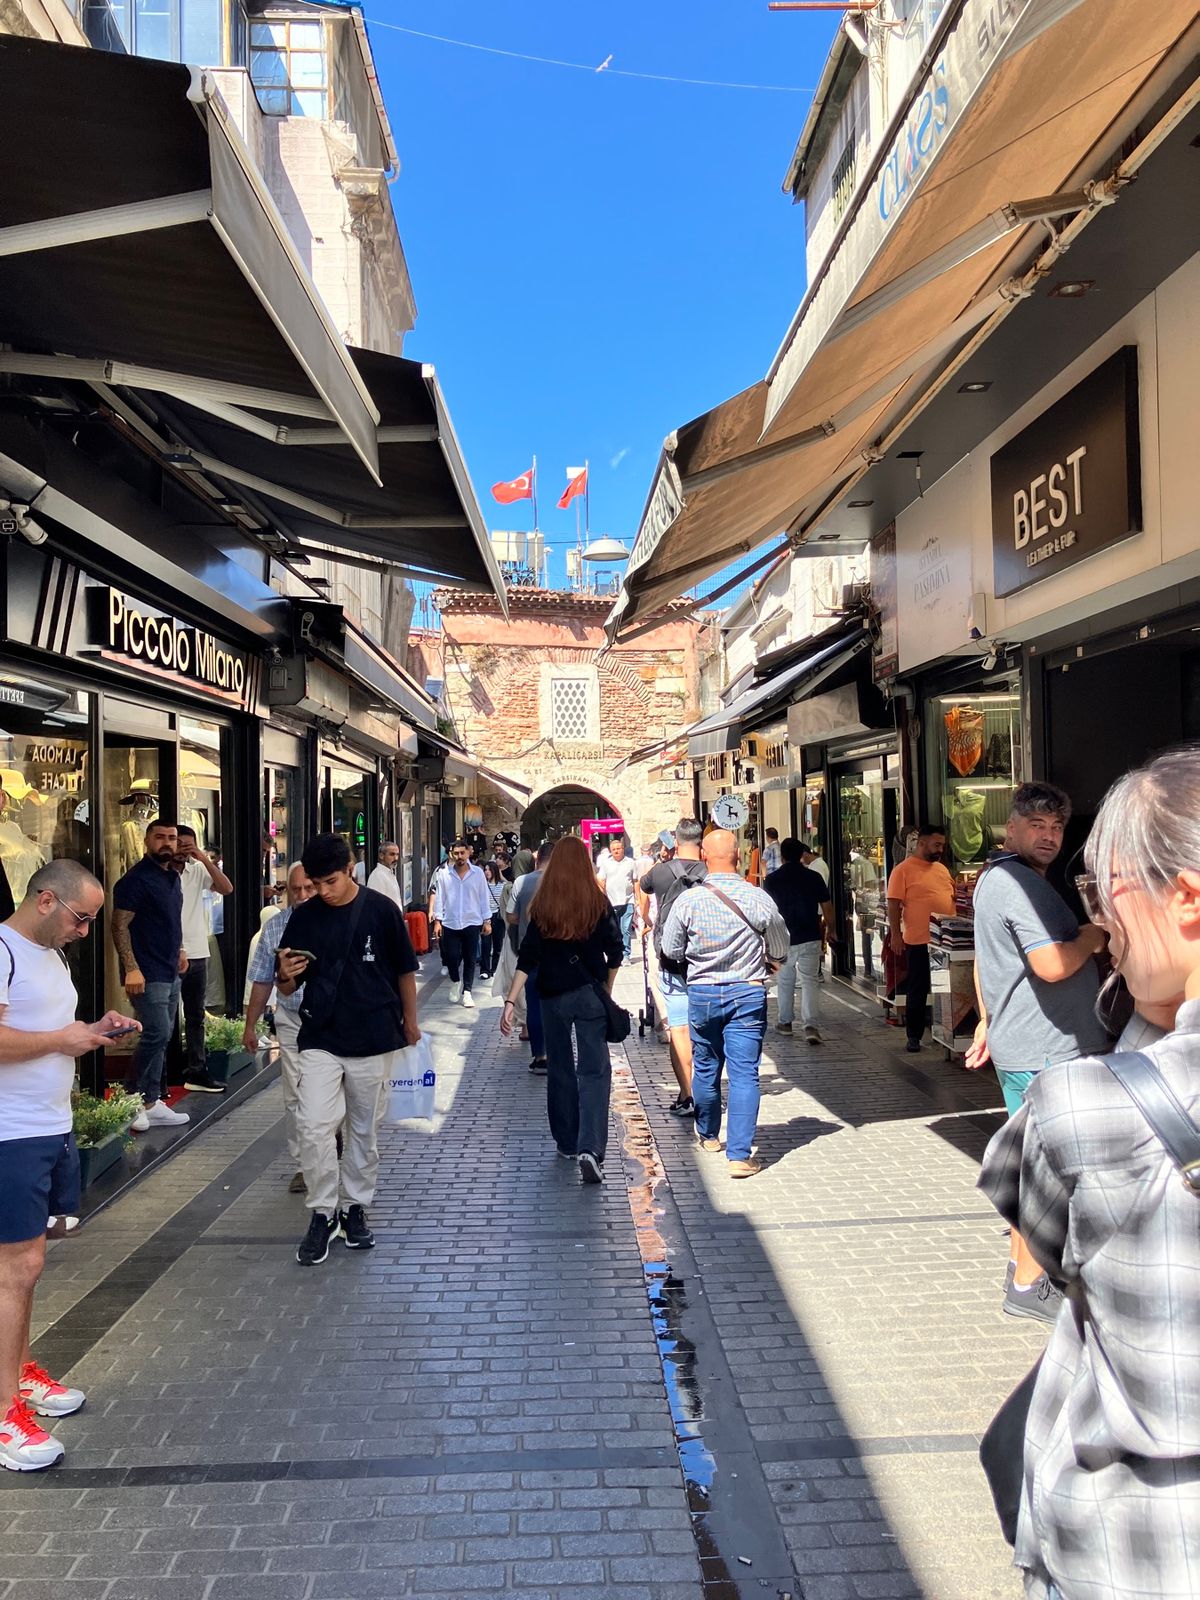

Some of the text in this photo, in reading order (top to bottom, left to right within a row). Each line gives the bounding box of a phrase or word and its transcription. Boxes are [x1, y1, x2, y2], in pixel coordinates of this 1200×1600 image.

[1013, 445, 1087, 551] BEST
[1060, 530, 1077, 550] FUR
[109, 585, 244, 693] Piccolo Milano
[718, 795, 737, 805] MODA
[737, 797, 749, 811] CAFE
[721, 821, 741, 829] COFFEE
